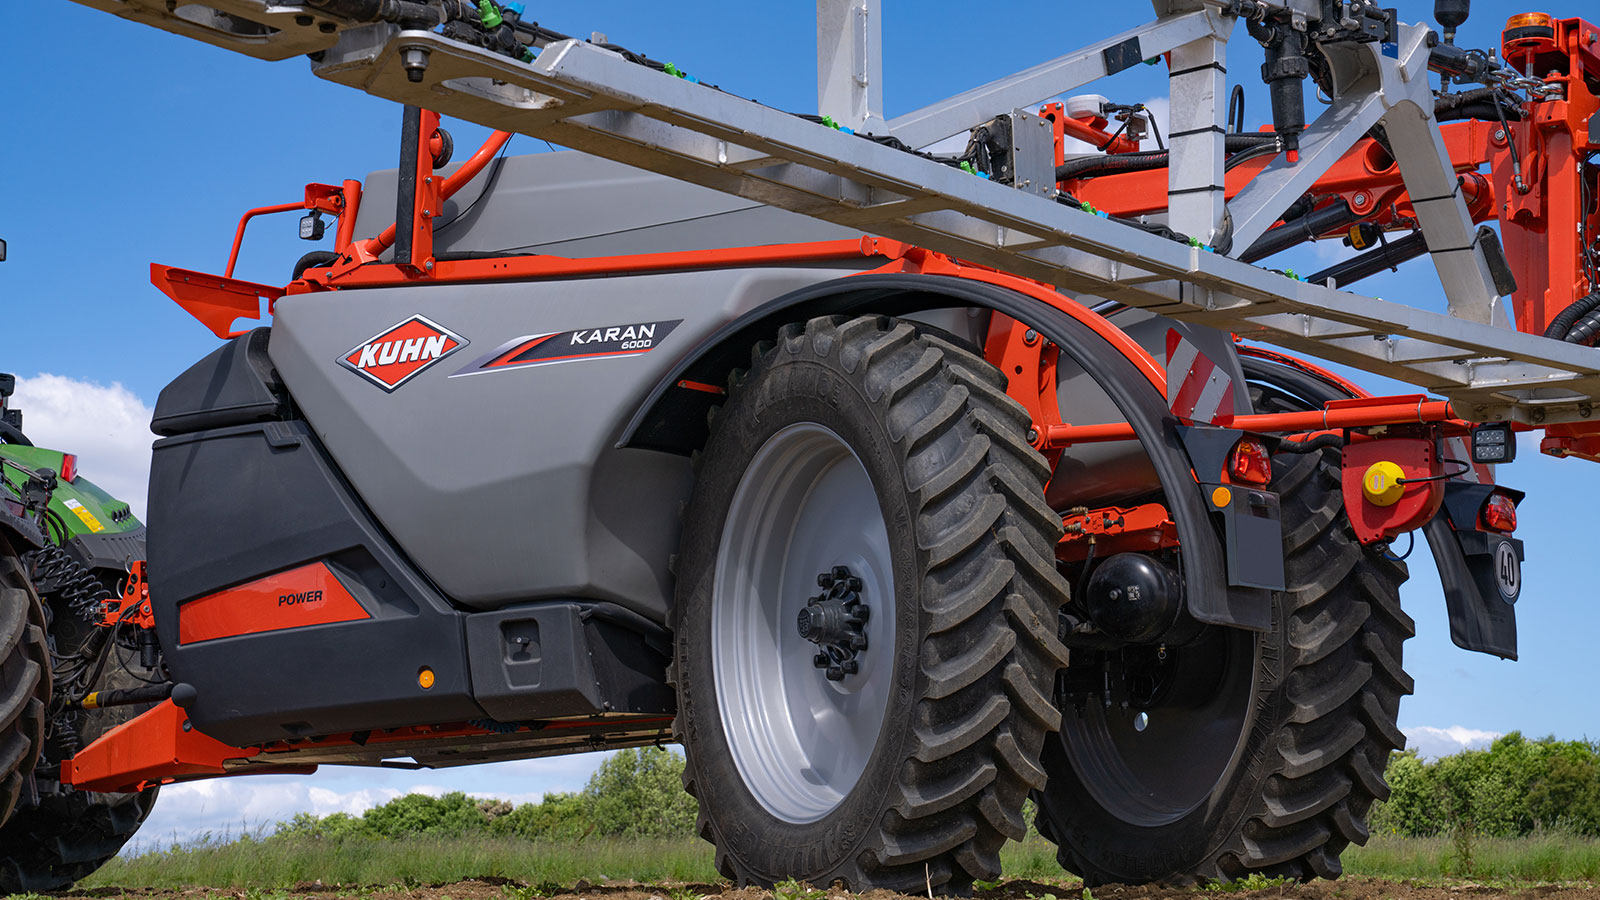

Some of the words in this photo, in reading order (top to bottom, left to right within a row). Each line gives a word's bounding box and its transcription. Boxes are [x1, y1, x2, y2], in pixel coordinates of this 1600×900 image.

[570, 324, 656, 346] KARAN
[621, 339, 652, 350] 6000
[357, 334, 448, 369] KUHN
[1501, 551, 1515, 587] 40
[278, 590, 323, 607] POWER
